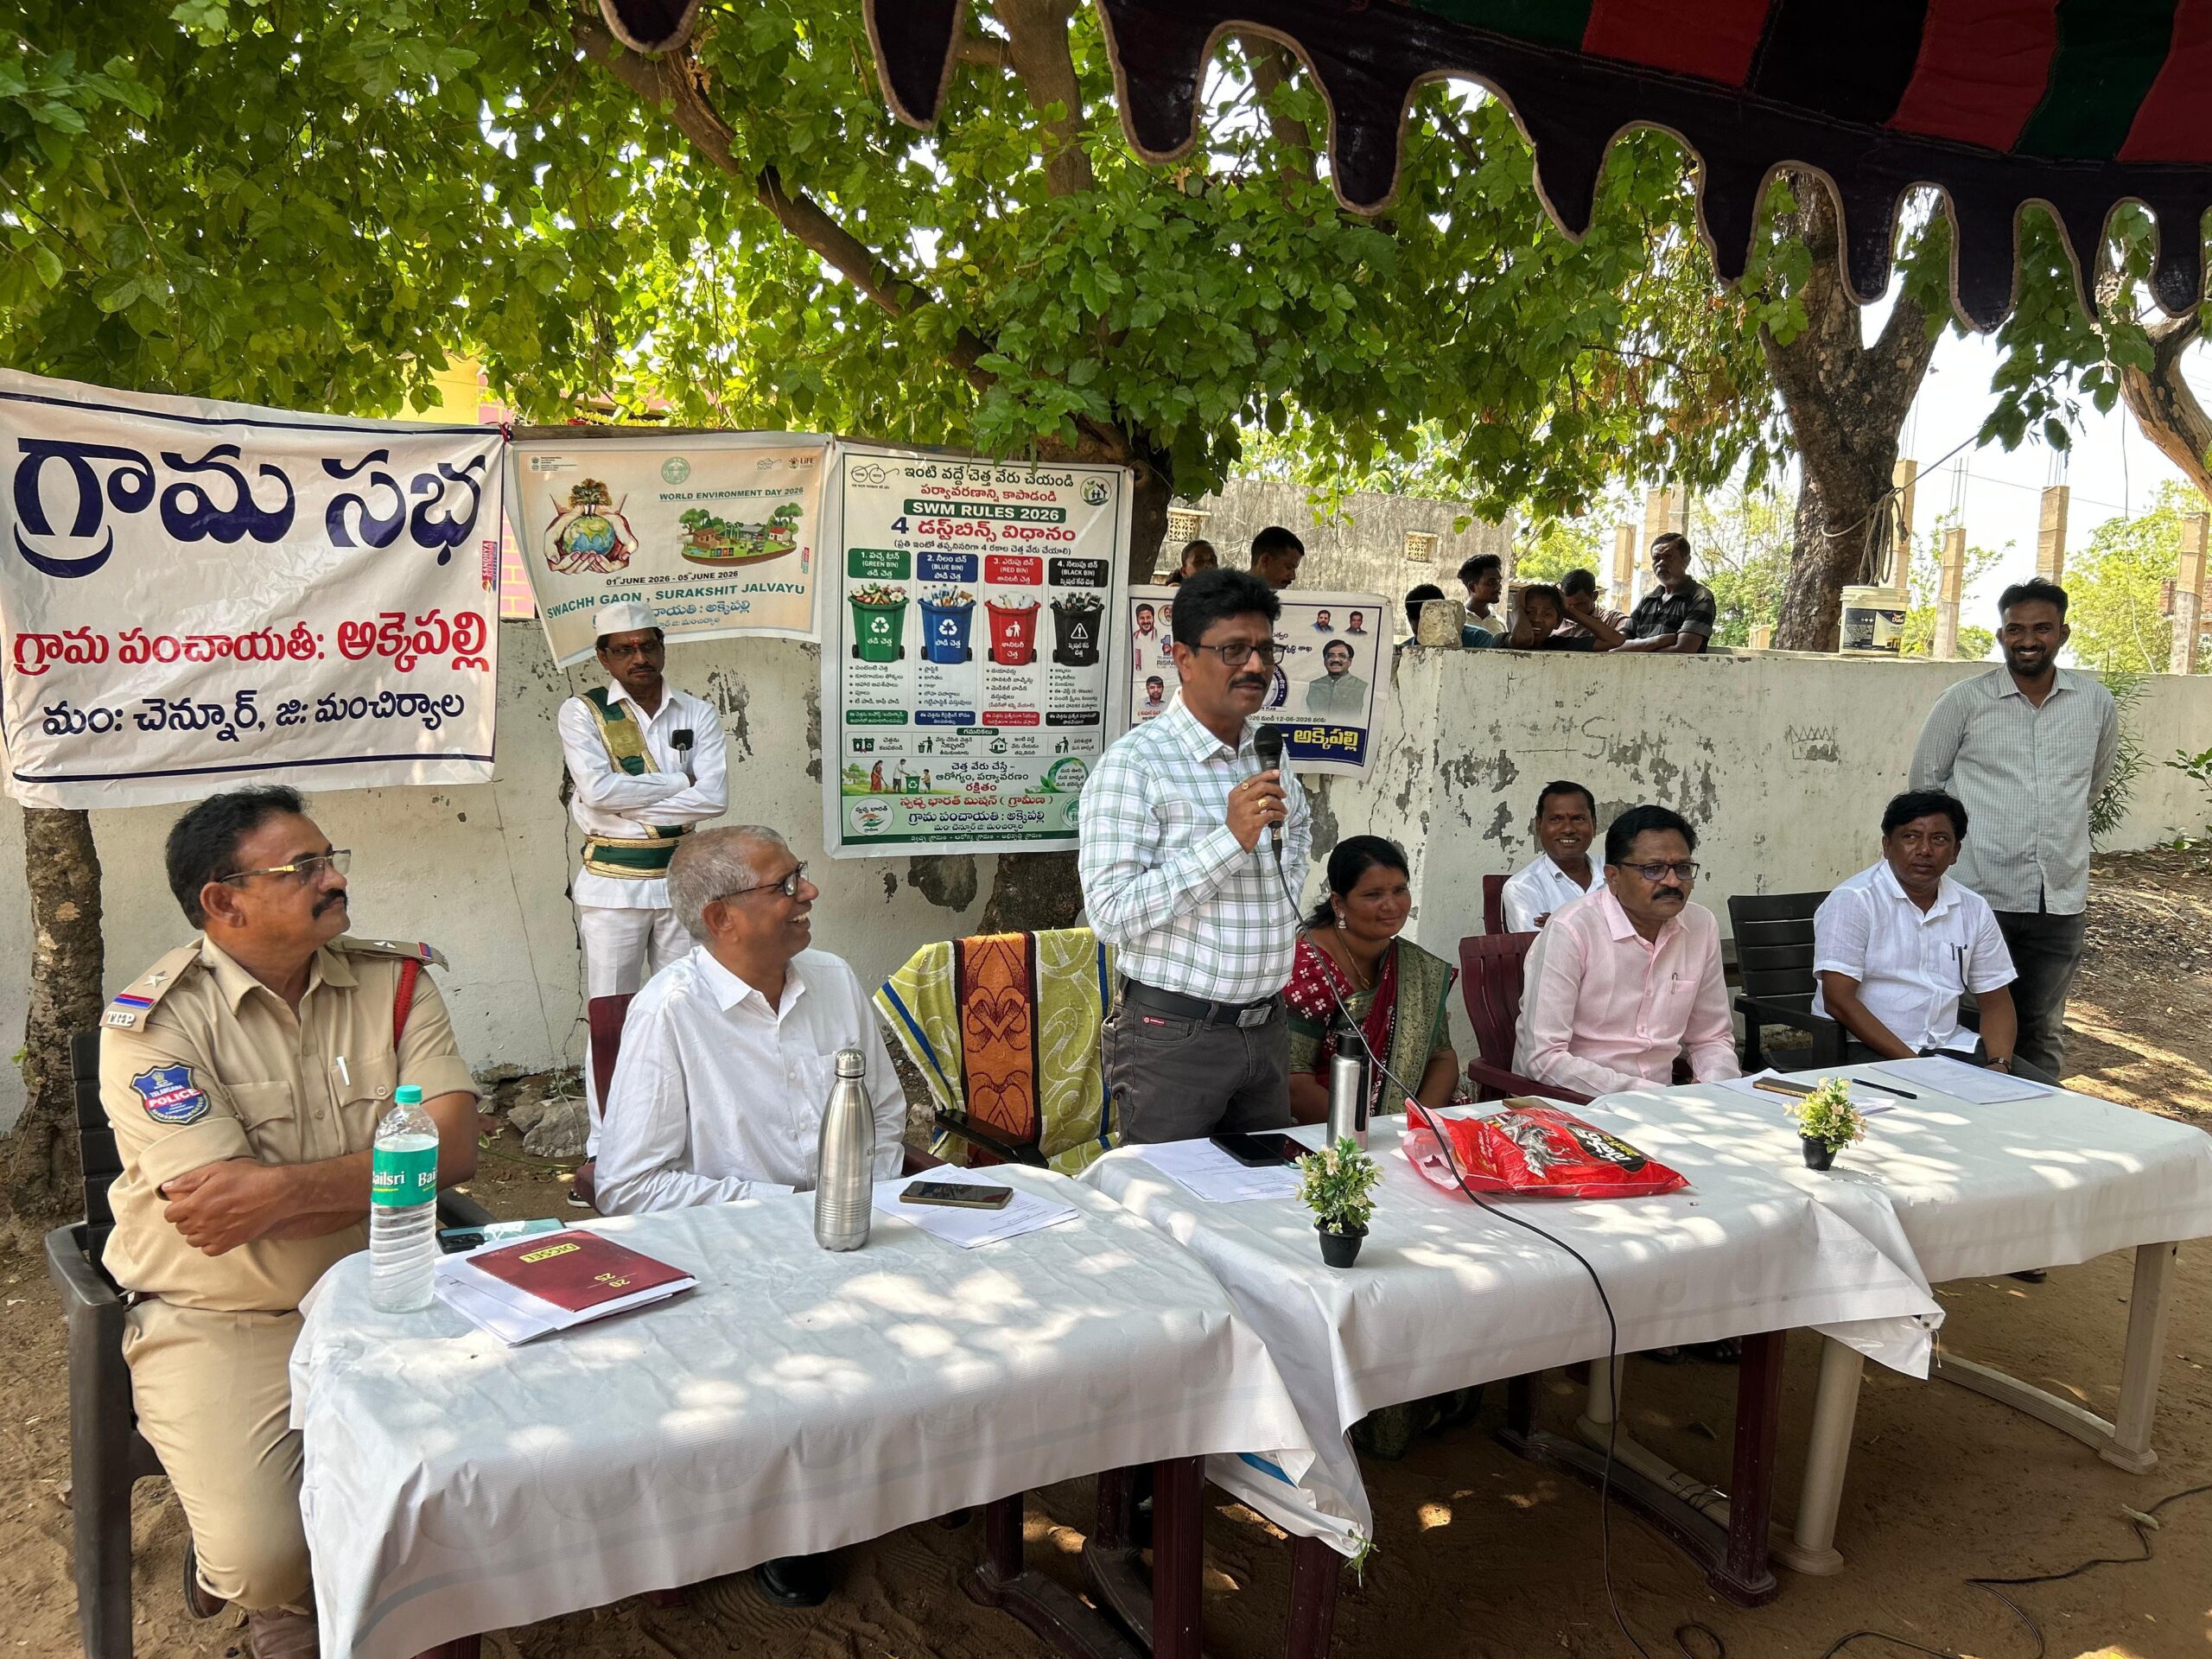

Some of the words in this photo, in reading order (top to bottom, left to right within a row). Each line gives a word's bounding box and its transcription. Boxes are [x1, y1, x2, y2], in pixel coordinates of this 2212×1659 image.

[905, 466, 937, 478] ఇంటి
[942, 466, 964, 486] వద్దే
[969, 467, 991, 486] చెత్త
[995, 469, 1020, 484] వేరు
[1024, 474, 1074, 487] చేయండి
[696, 490, 762, 499] ENVIRONMENT
[785, 486, 804, 495] 2026
[920, 484, 999, 502] పర్యావరణాన్ని
[1002, 490, 1057, 502] కాపాడండి
[14, 437, 296, 579] గ్రామ
[321, 448, 486, 566] సభ
[912, 502, 955, 515] SWM
[962, 505, 1014, 518] RULES
[1020, 508, 1059, 520] 2026
[891, 517, 909, 534] 4
[1002, 524, 1076, 543] విధానం
[548, 596, 594, 619] SWACHH
[600, 593, 641, 604] GAON
[656, 585, 738, 600] SURAKSHIT
[741, 583, 804, 594] JALVAYU
[14, 626, 109, 676] గ్రామ
[118, 621, 325, 664] పంచాయతీ:
[337, 609, 490, 672] అక్కెపల్లి
[42, 699, 123, 738] మం:
[133, 690, 264, 742] చెన్నూర్,
[276, 702, 308, 726] జి:
[315, 690, 465, 729] మంచిర్యాల
[1294, 727, 1358, 752] అక్కెపల్లి
[951, 762, 968, 772] చెత్త
[971, 761, 988, 770] వేరు
[977, 772, 1028, 783] పర్యావరణం
[966, 782, 996, 794] రక్షితం
[928, 796, 961, 807] భారత్
[964, 796, 997, 806] మిషన్
[1007, 795, 1046, 808] గ్రామీణ
[908, 812, 937, 826] గ్రామ
[1007, 810, 1045, 823] అక్కెపల్లి
[149, 1089, 200, 1107] POLICE
[594, 1273, 615, 1281] 25
